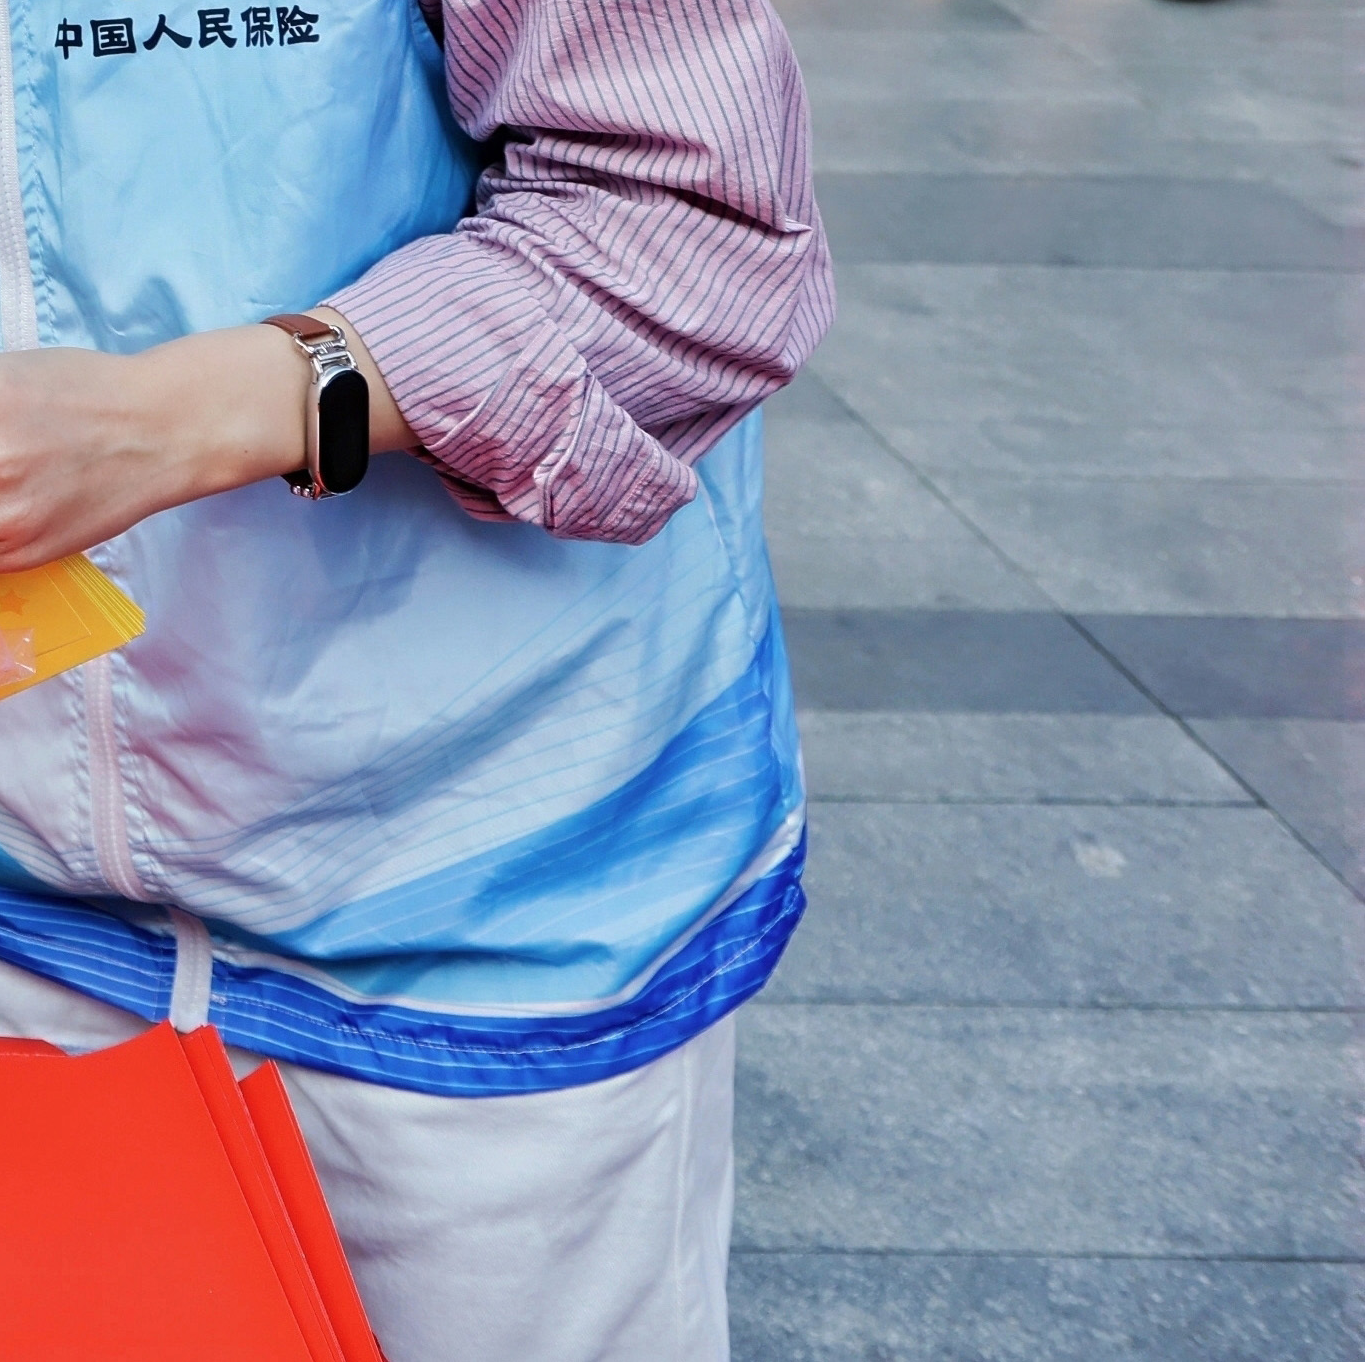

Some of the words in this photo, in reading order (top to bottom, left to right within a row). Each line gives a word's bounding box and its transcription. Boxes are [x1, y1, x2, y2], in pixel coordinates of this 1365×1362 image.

[55, 5, 320, 59] 中国人民保险
